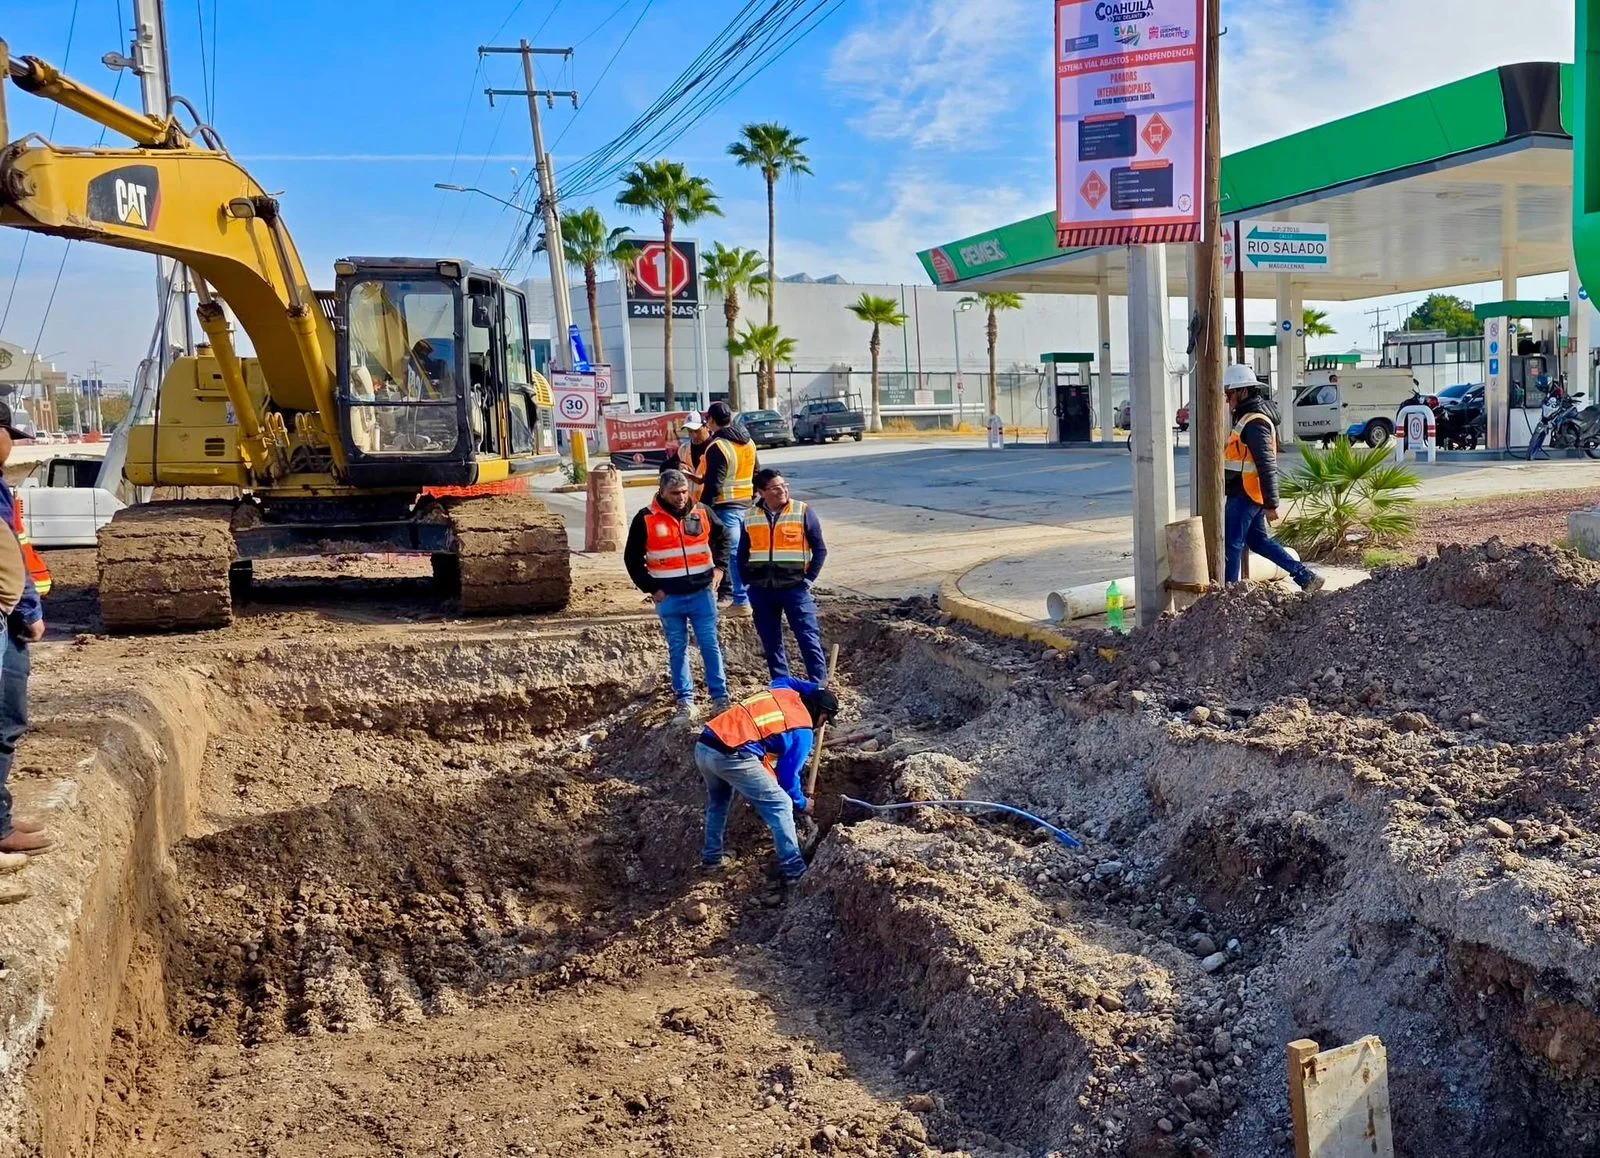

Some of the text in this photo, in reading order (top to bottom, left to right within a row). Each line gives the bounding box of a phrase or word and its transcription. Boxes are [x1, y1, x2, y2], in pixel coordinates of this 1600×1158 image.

[1095, 0, 1154, 20] COAHUILA
[1058, 64, 1083, 73] SISTEMA
[1099, 56, 1130, 67] ABASTOS
[1135, 47, 1194, 62] INDEPENDENCIA
[1110, 71, 1137, 83] PARADAS
[1096, 82, 1152, 98] INTERMUNICIPALES
[115, 178, 147, 227] CAT
[960, 238, 1008, 268] PEMEX
[1248, 241, 1324, 254] RIO SALADO
[634, 305, 649, 315] 24
[566, 399, 583, 410] 30
[1297, 419, 1331, 427] TELMEX
[1412, 421, 1420, 430] 10
